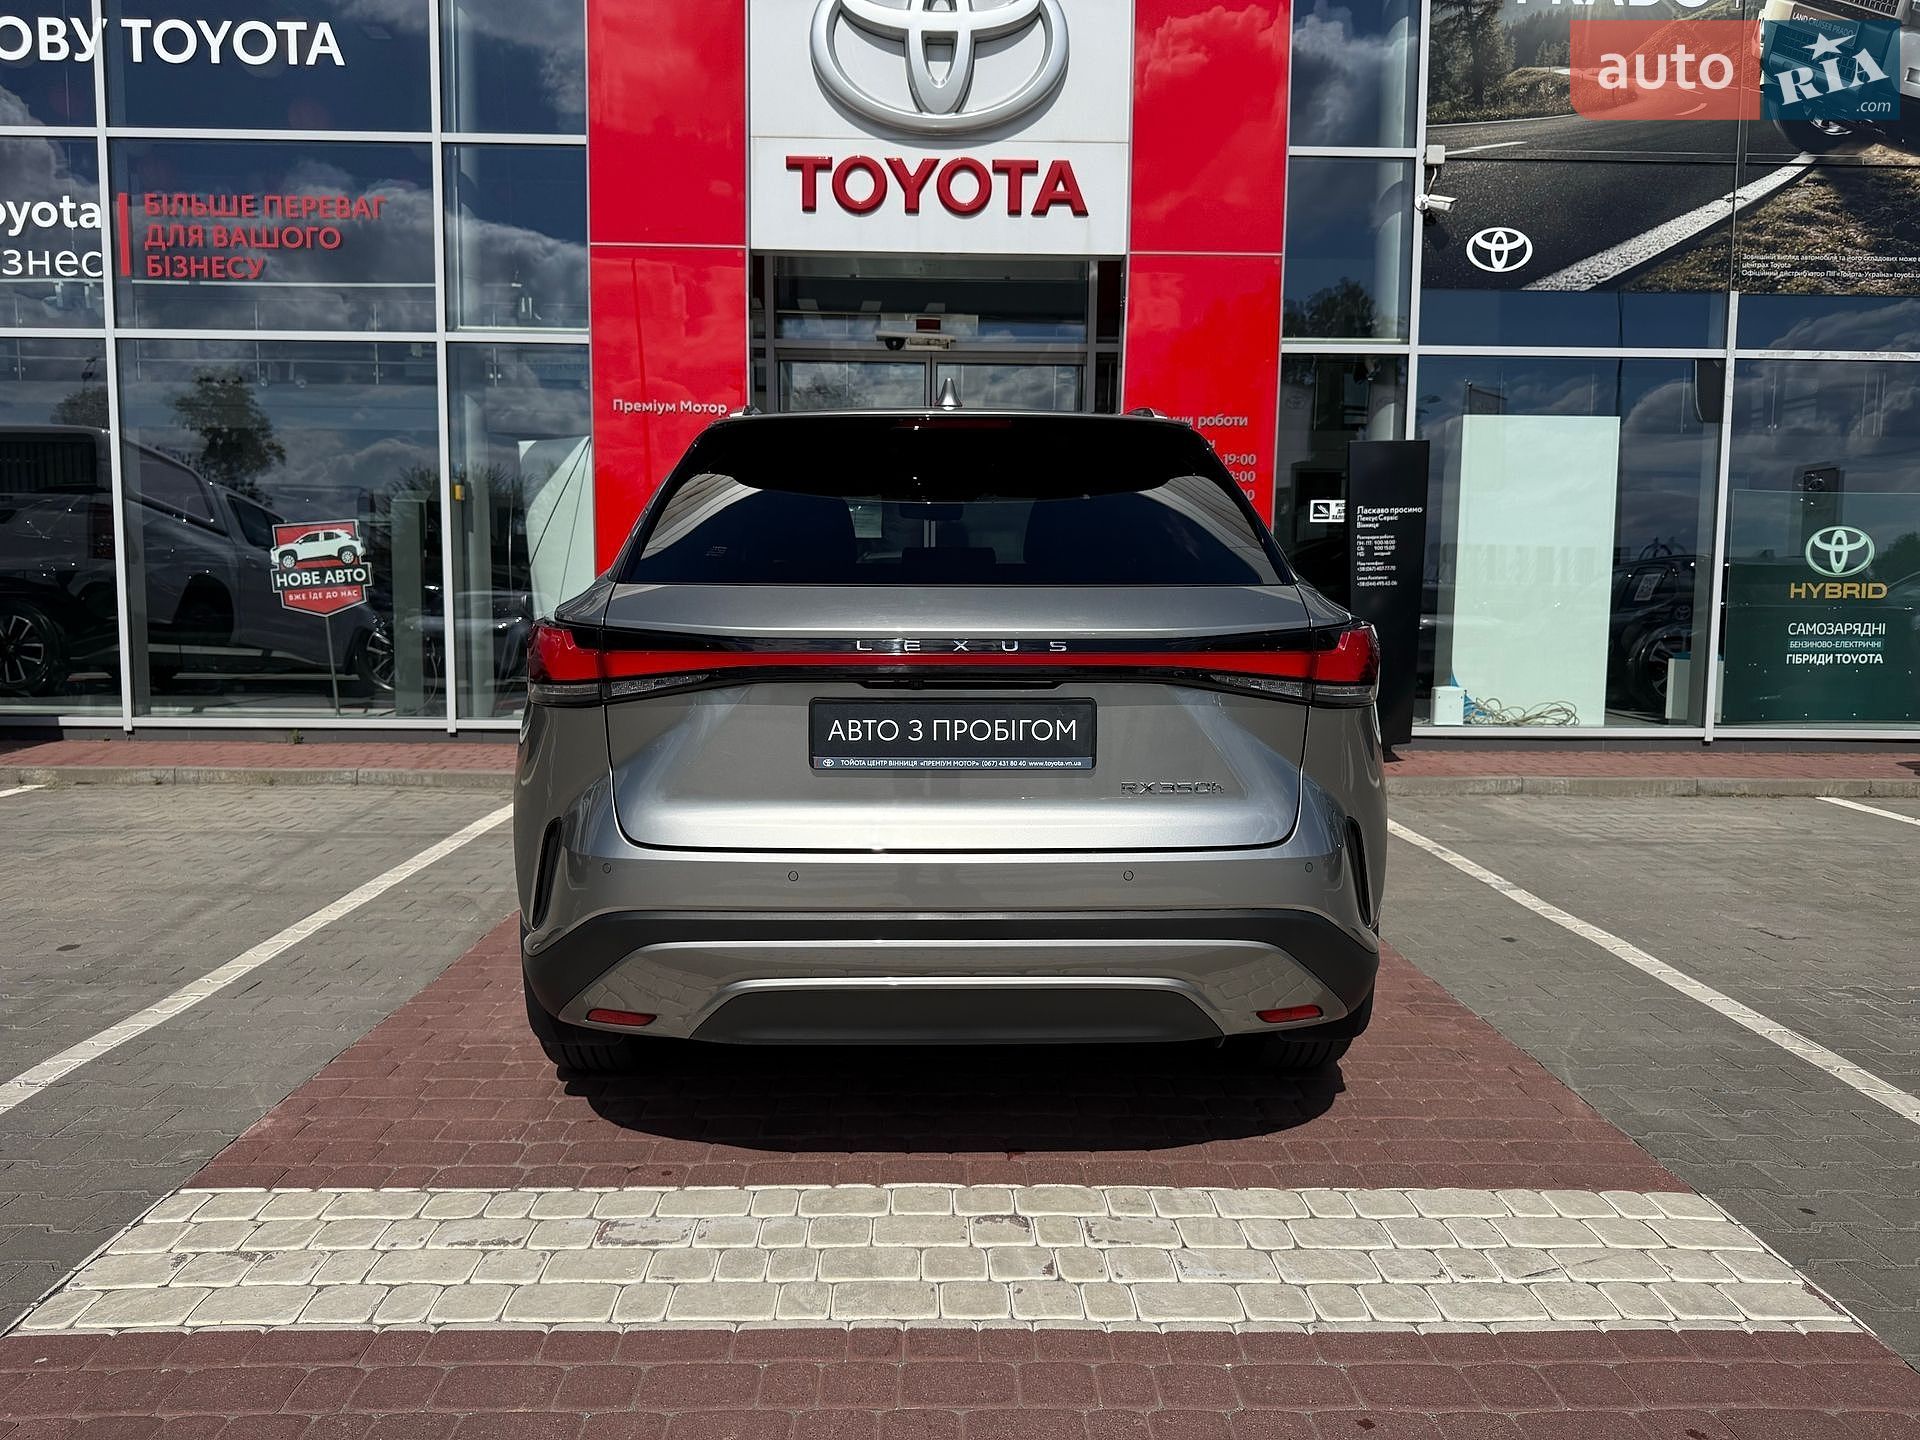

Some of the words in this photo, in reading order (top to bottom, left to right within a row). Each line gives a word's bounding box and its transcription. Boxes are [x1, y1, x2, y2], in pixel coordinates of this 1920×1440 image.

[120, 18, 346, 66] TOYOTA
[785, 155, 1089, 217] TOYOTA
[144, 193, 257, 217] БІЛЬШЕ
[264, 195, 387, 220] ПЕРЕВАГ
[0, 195, 102, 237] yota
[144, 224, 203, 250] ДЛЯ
[212, 225, 342, 250] ВАШОГО
[146, 255, 265, 280] БІЗНЕСУ
[612, 398, 676, 415] Преміум
[680, 399, 727, 416] Мотор
[1197, 413, 1249, 429] роботи
[1357, 505, 1389, 515] Ласкаво
[1389, 506, 1423, 515] просимо
[275, 571, 321, 587] НОВЕ
[324, 568, 367, 584] АВТО
[326, 591, 338, 599] ДО
[340, 589, 358, 597] НАС
[1790, 582, 1888, 599] HYBRID
[1788, 622, 1886, 637] САМОЗАРЯДНІ
[856, 640, 1067, 652] LEXUS
[1789, 640, 1882, 649] БЕНЗИНОВО-ЕЛЕКТРИЧНІ
[1786, 653, 1833, 666] ГІБРИДИ
[1835, 653, 1884, 664] TOYOTA
[827, 719, 900, 741] АВТО
[907, 719, 923, 741] З
[933, 719, 1077, 741] ПРОБІГОМ
[840, 758, 866, 767] ТОЙОТА
[867, 760, 888, 768] ЦЕНТР
[981, 760, 998, 768] (067)
[1028, 760, 1082, 768] www.toyota.vn.ua
